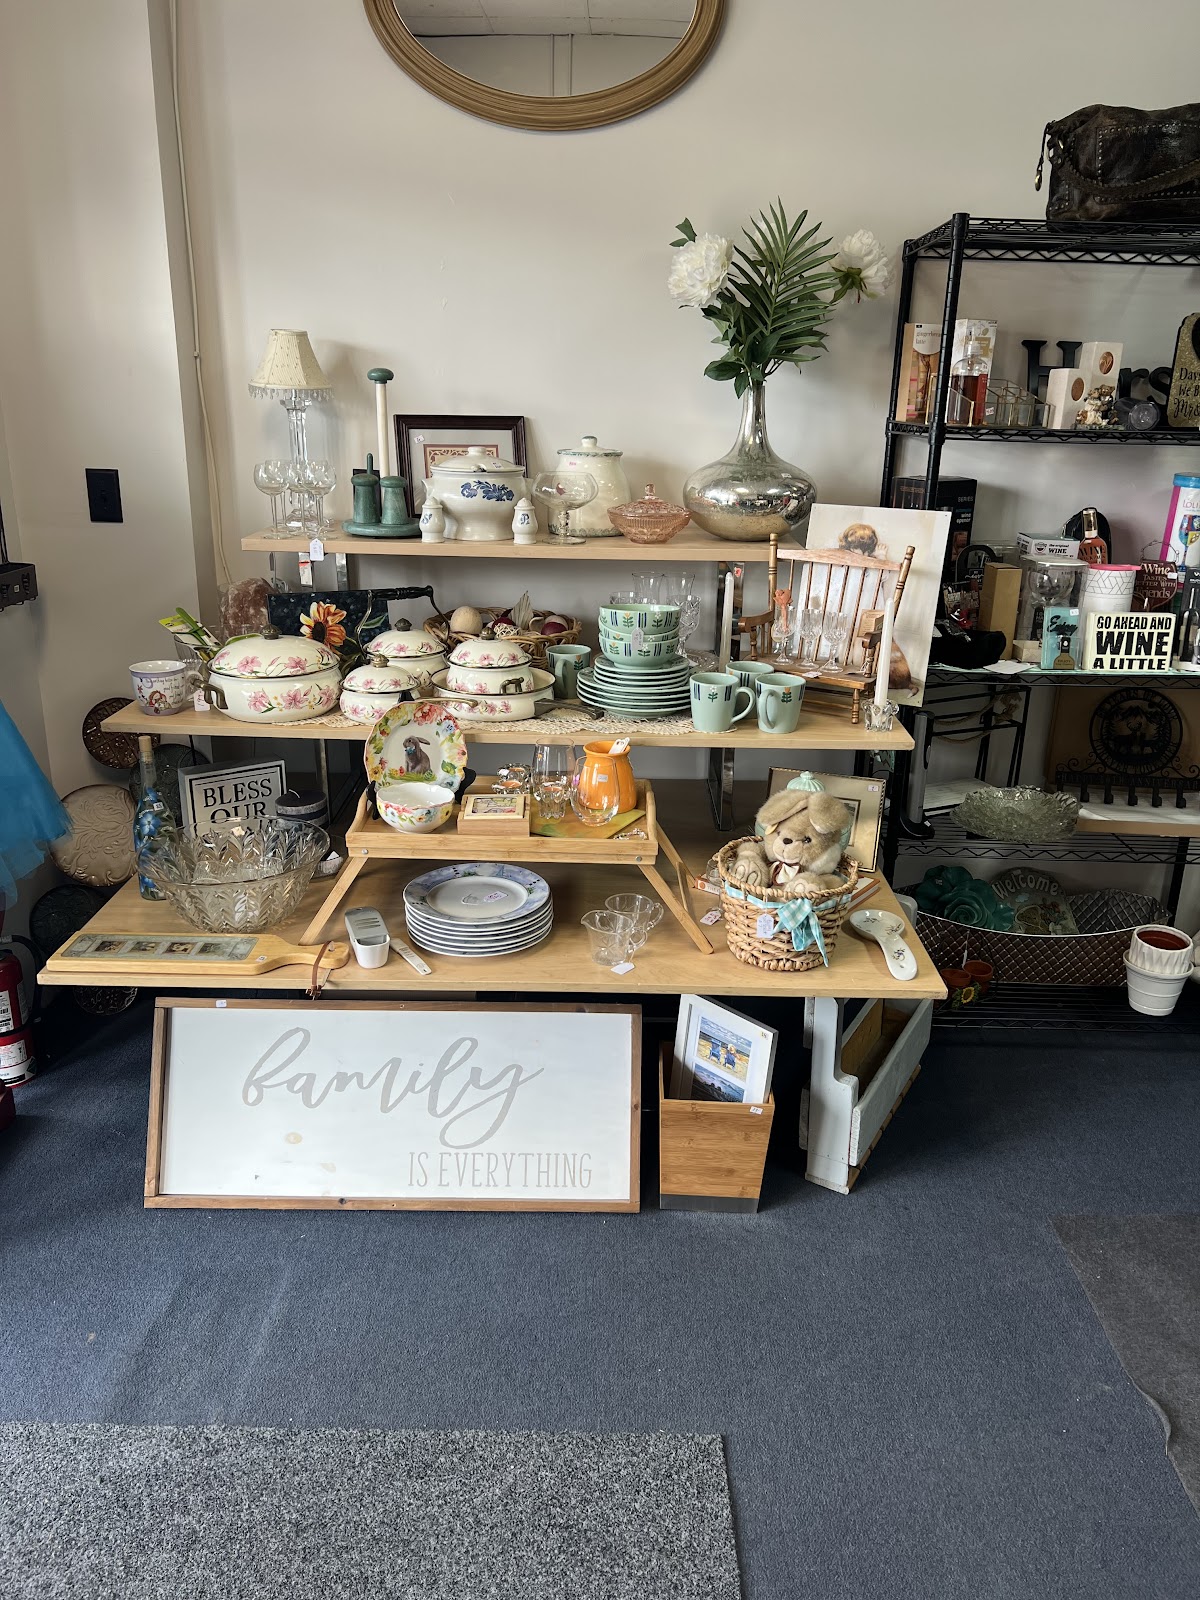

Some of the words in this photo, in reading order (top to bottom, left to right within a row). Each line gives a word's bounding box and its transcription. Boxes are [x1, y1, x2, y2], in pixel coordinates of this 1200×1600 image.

[1179, 384, 1191, 396] We
[1143, 563, 1170, 575] Wine
[1047, 615, 1079, 636] Enjoy
[1097, 616, 1112, 629] GO
[1113, 616, 1147, 630] AHEAD
[1150, 616, 1172, 630] AND
[1096, 631, 1170, 656] WINE
[1093, 657, 1105, 670] A
[1109, 658, 1166, 670] LITTLE
[202, 777, 273, 809] BLESS
[991, 873, 1059, 900] Welcome
[241, 1026, 544, 1149] family
[408, 1151, 429, 1188] IS
[437, 1152, 592, 1190] EVERYTHING
